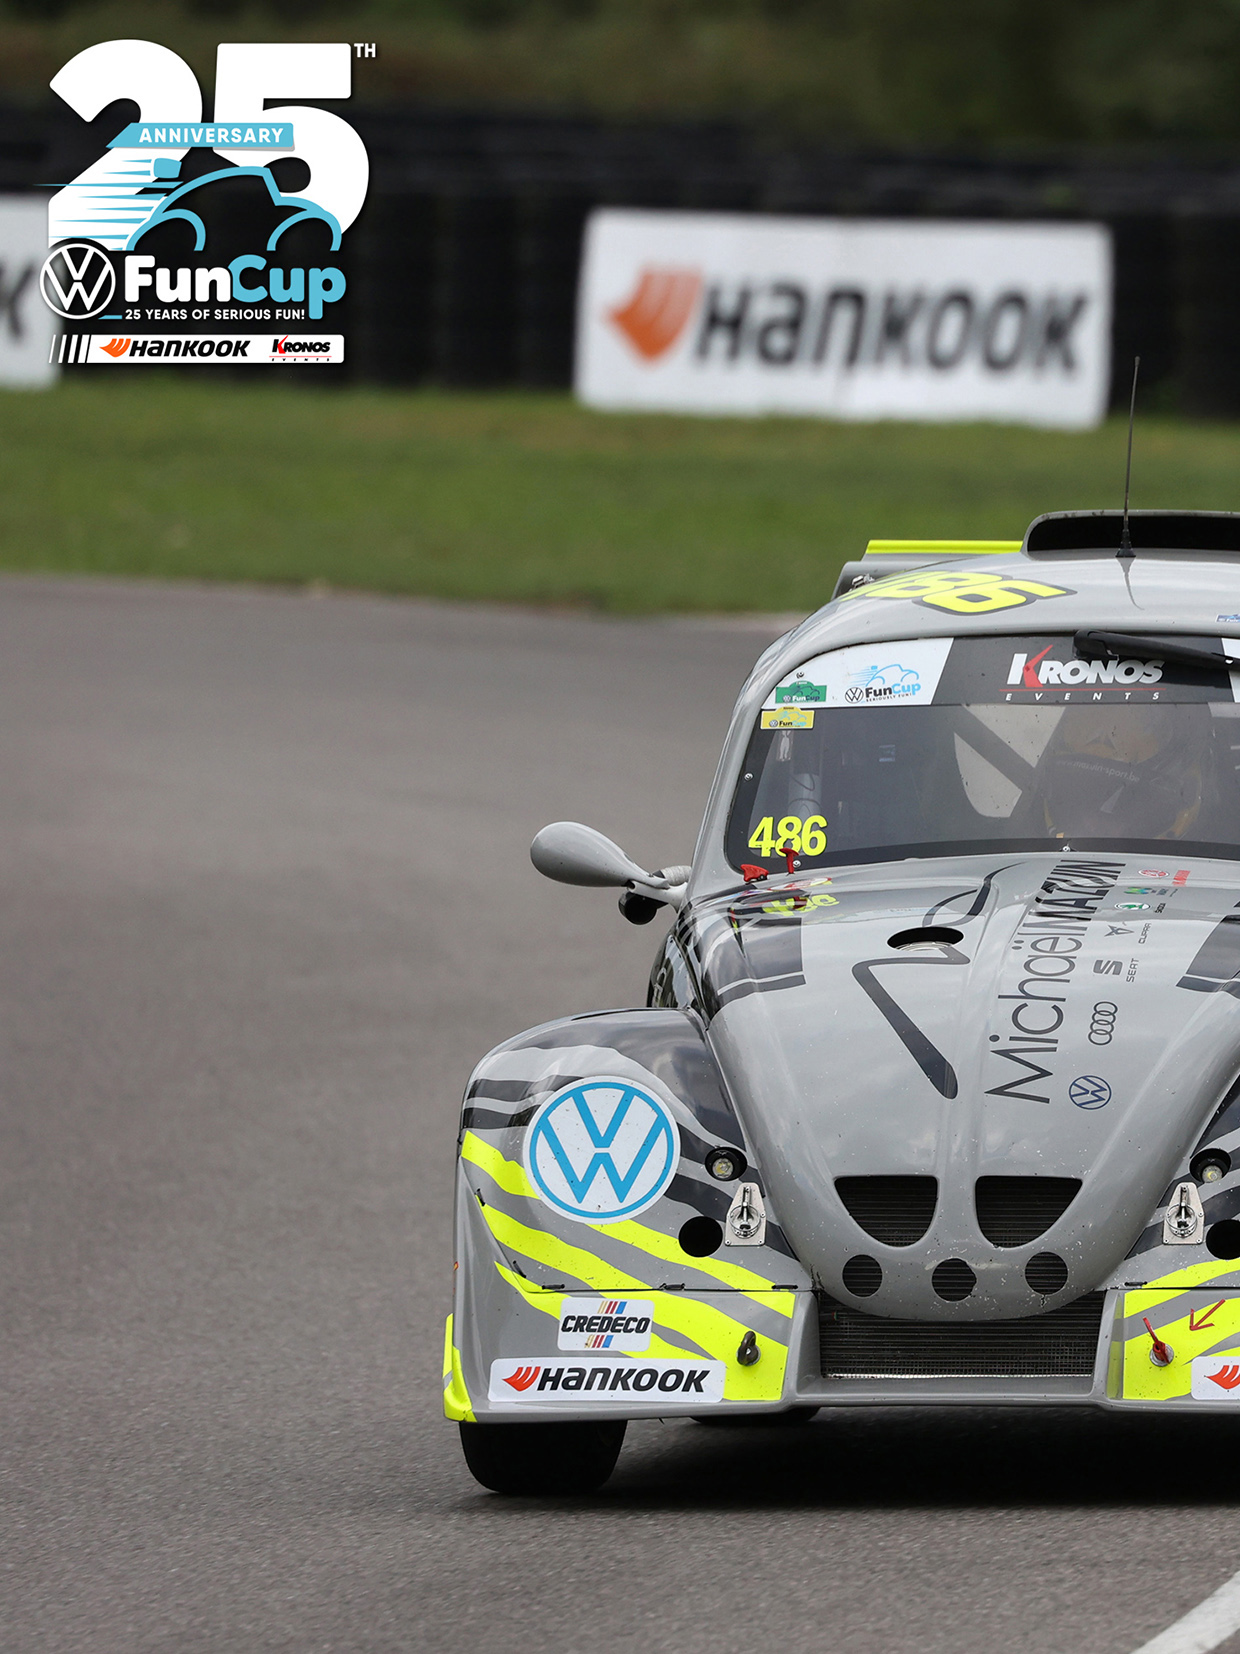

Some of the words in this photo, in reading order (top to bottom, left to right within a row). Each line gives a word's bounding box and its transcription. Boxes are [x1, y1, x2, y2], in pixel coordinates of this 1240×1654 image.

[1006, 644, 1165, 688] KRONOS
[792, 694, 821, 702] FunCup
[865, 682, 921, 699] FunCup
[1005, 692, 1160, 701] EVENTS
[779, 720, 807, 728] FunCup
[748, 815, 828, 857] 486
[560, 1314, 651, 1334] CREDECO
